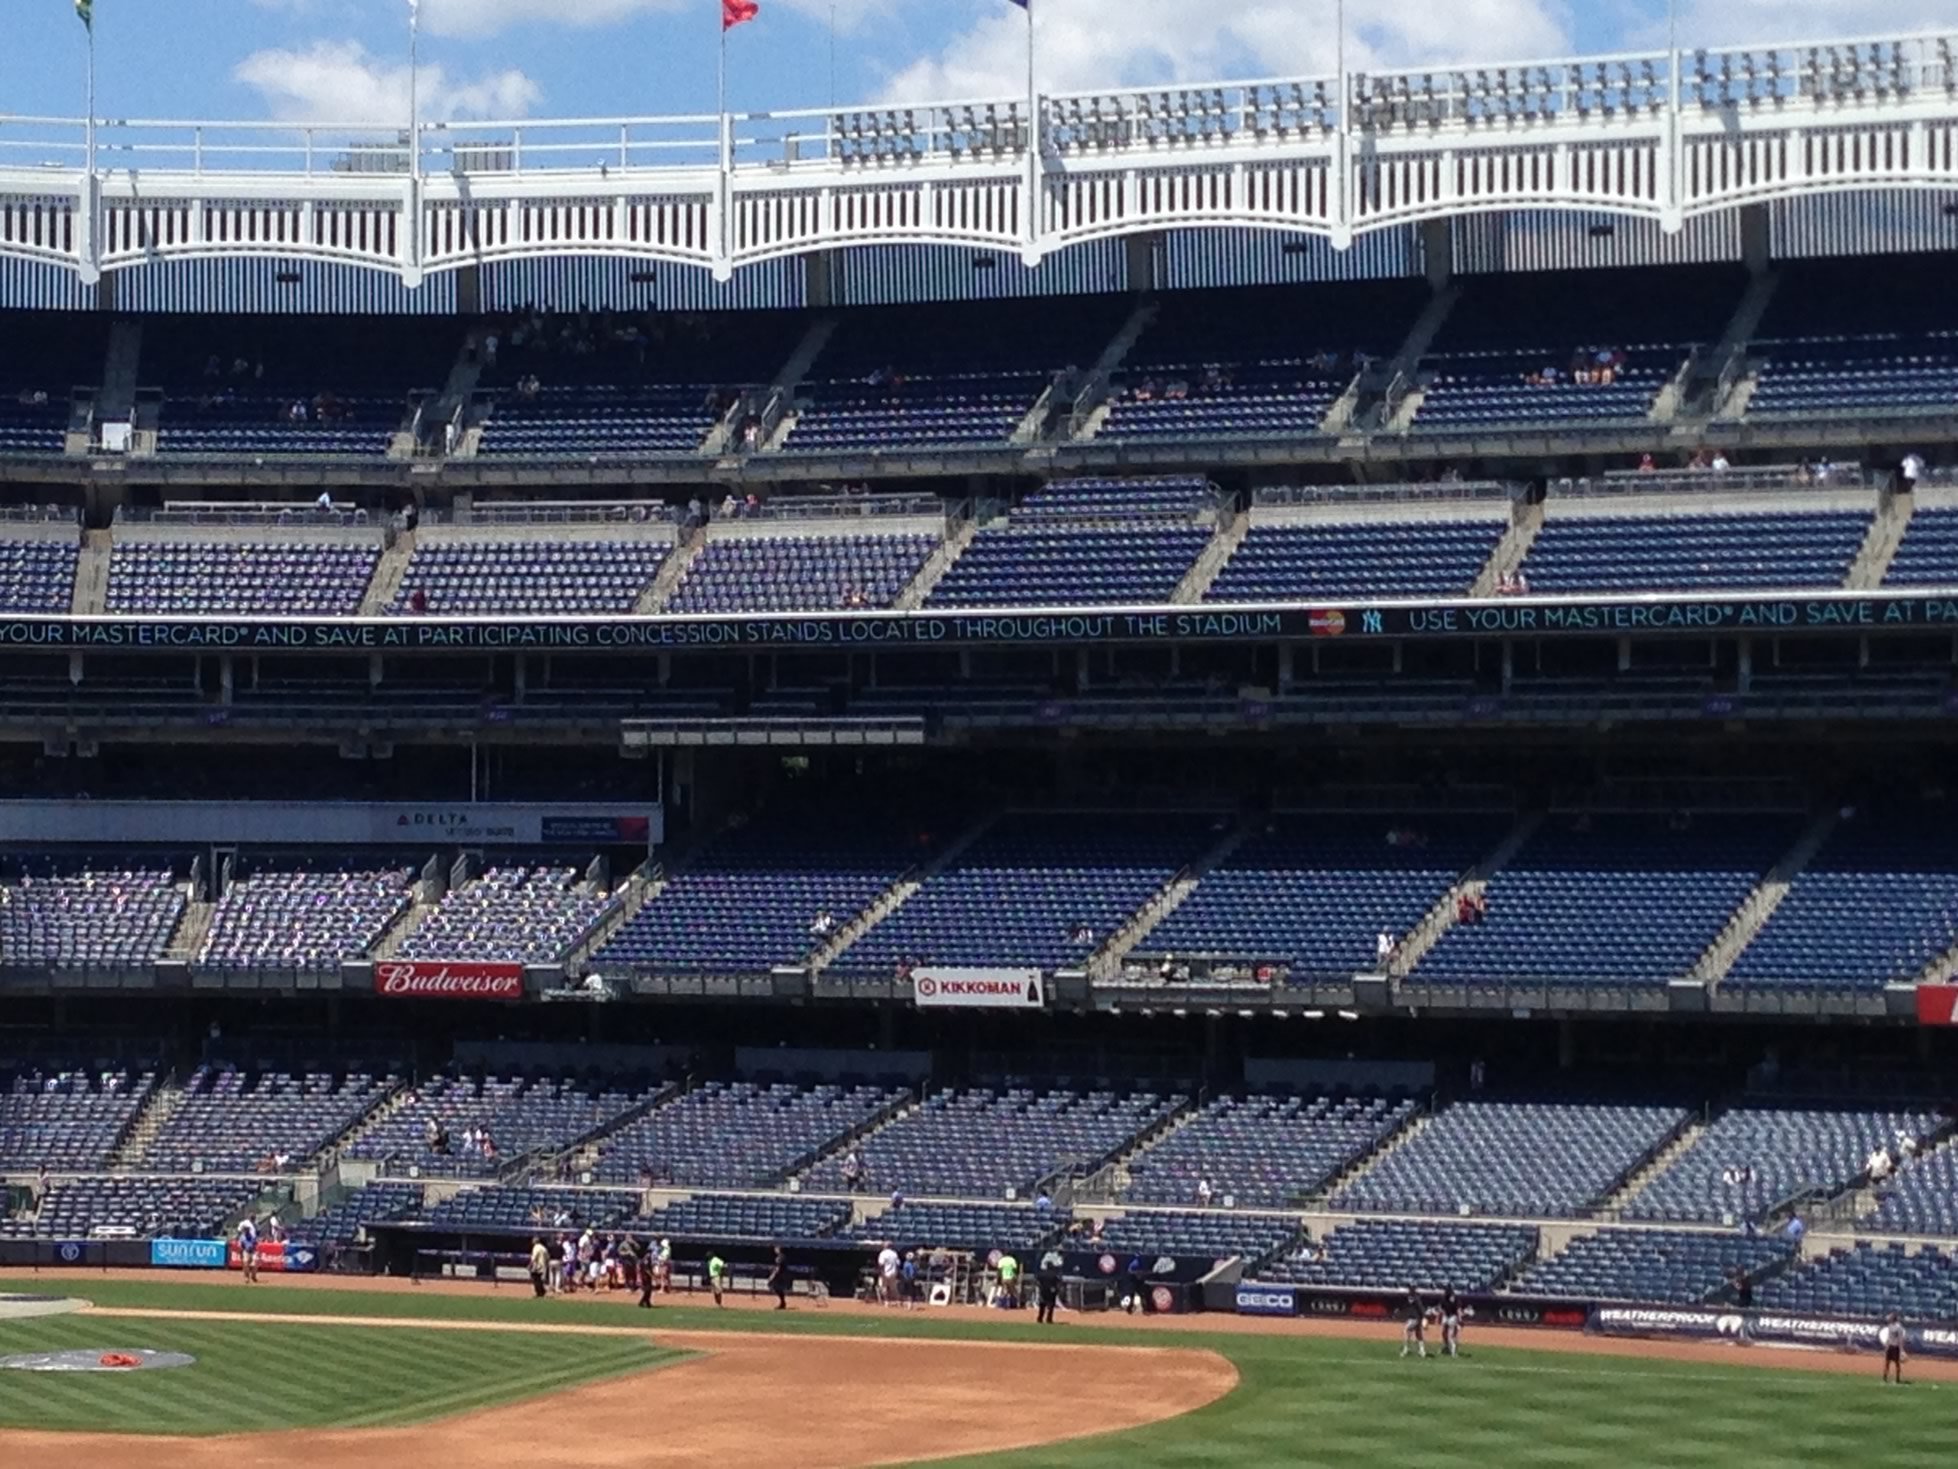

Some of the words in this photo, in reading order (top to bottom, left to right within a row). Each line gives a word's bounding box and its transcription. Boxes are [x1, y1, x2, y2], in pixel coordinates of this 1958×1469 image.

[1409, 610, 1458, 631] USE
[1465, 608, 1536, 630] YOUR
[1738, 603, 1798, 625] AND
[1806, 601, 1874, 624] SAVE
[1883, 600, 1917, 622] AT
[0, 623, 64, 643] YOUR
[254, 626, 307, 645] AND
[314, 627, 375, 645] SAVE
[383, 627, 411, 645] AT
[418, 625, 590, 645] PARTICIPATING
[596, 624, 739, 644] CONCESSION
[745, 622, 833, 642] STANDS
[839, 620, 946, 641] LOCATED
[953, 617, 1115, 639] THROUGHOUT
[1124, 615, 1168, 635] THE
[1176, 613, 1282, 634] STADIUM
[414, 813, 468, 825] DELTA
[378, 964, 518, 992] Budweiser
[940, 981, 1021, 995] KIKKOMAN
[1236, 1292, 1294, 1308] GEICO
